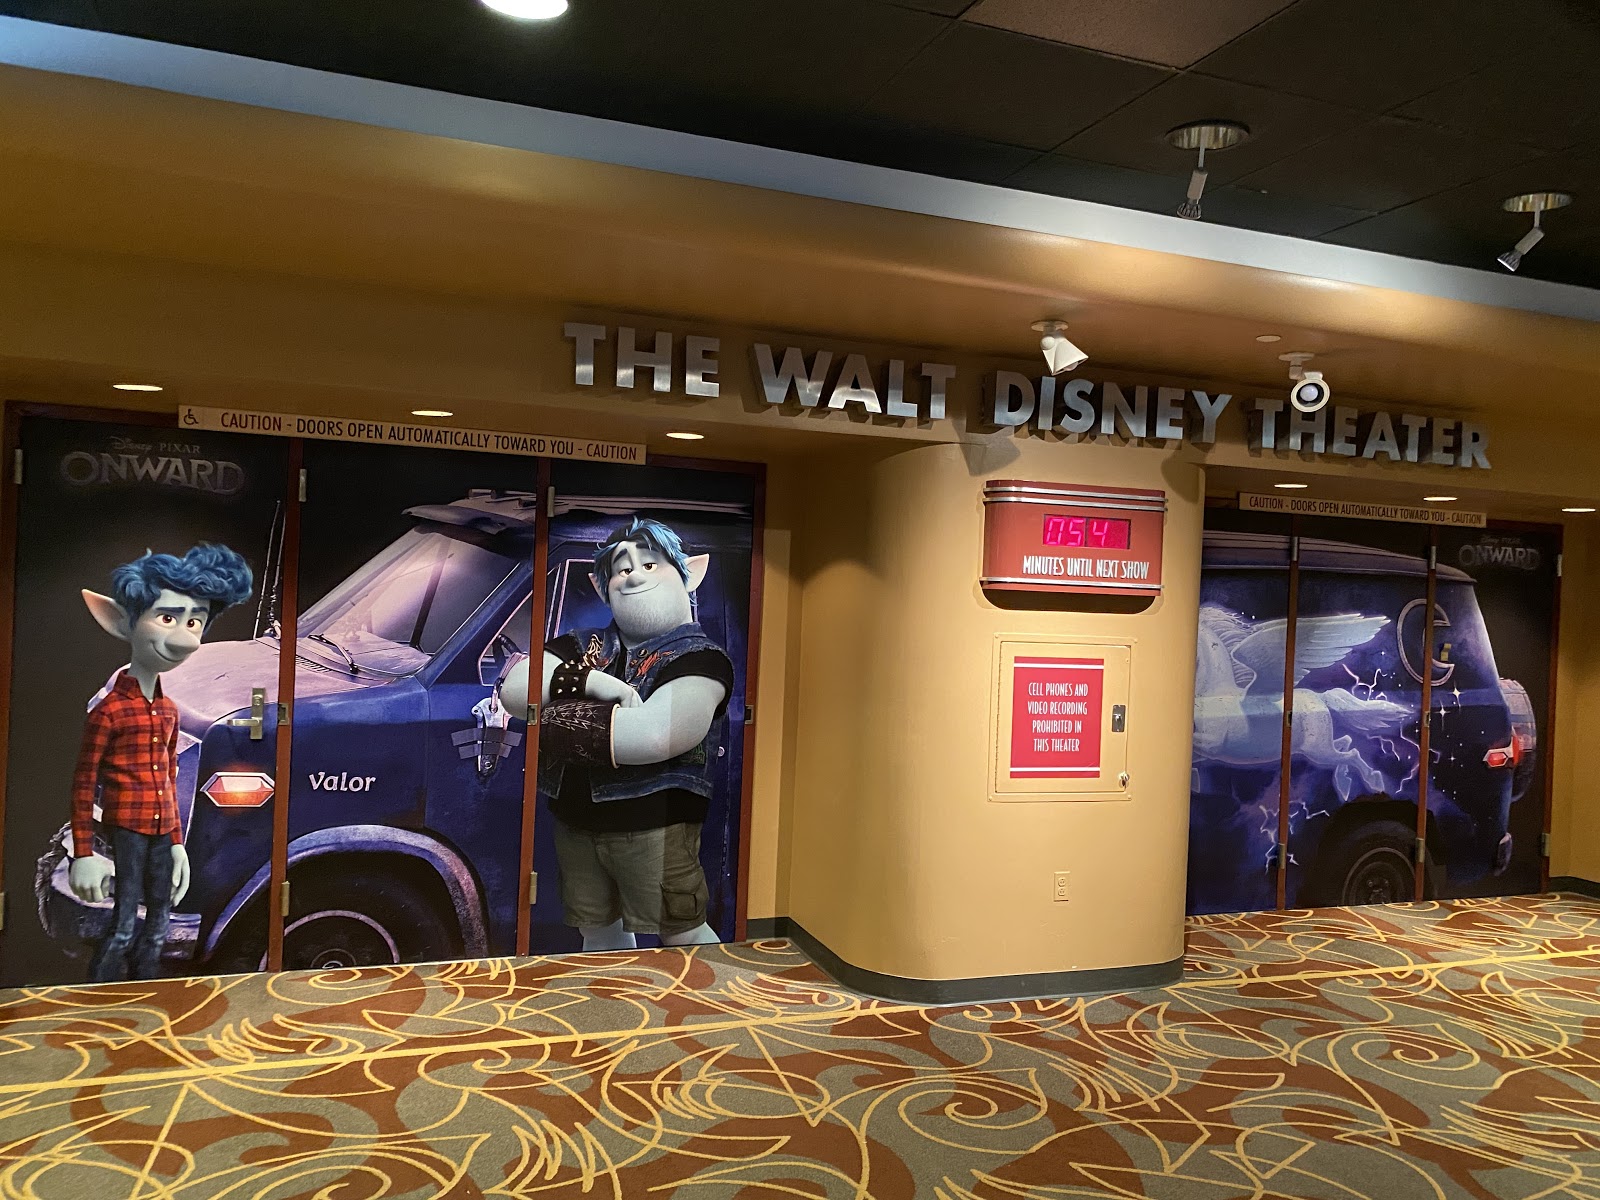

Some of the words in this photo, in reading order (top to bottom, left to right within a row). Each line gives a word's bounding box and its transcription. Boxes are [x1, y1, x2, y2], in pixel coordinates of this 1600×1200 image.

[563, 321, 721, 398] THE
[753, 342, 957, 420] WALT
[993, 369, 1233, 444] DISNEY
[1254, 397, 1493, 470] THEATER
[221, 412, 282, 432] CAUTION
[296, 418, 343, 436] DOORS
[347, 422, 384, 439] OPEN
[387, 424, 490, 449] AUTOMATICALLY
[494, 434, 546, 453] TOWARD
[549, 439, 574, 456] YOU
[586, 443, 637, 461] CAUTION
[160, 443, 201, 454] PIXAR
[60, 451, 246, 496] ONWARD
[1249, 496, 1283, 509] CAUTION
[1290, 499, 1317, 512] DOORS
[1318, 501, 1339, 514] OPEN
[1340, 503, 1398, 519] AUTOMATICALLY
[1399, 508, 1429, 521] TOWARD
[1430, 511, 1445, 522] YOU
[1451, 512, 1482, 525] CAUTION
[1022, 555, 1065, 576] MINUTES
[1067, 557, 1094, 577] UNTIL
[1096, 559, 1120, 578] NEXT
[1120, 560, 1149, 579] SHOW
[1458, 544, 1541, 571] ONWARD
[1028, 682, 1044, 696] CELL
[1045, 683, 1073, 697] PHONES
[1074, 683, 1089, 697] AND
[1027, 701, 1048, 715] VIDEO
[1049, 701, 1088, 715] RECORDING
[1032, 720, 1073, 733] PROHIBITED
[1074, 720, 1082, 734] IN
[1033, 738, 1049, 752] THIS
[1051, 739, 1080, 752] THEATER
[308, 771, 377, 792] Valor
